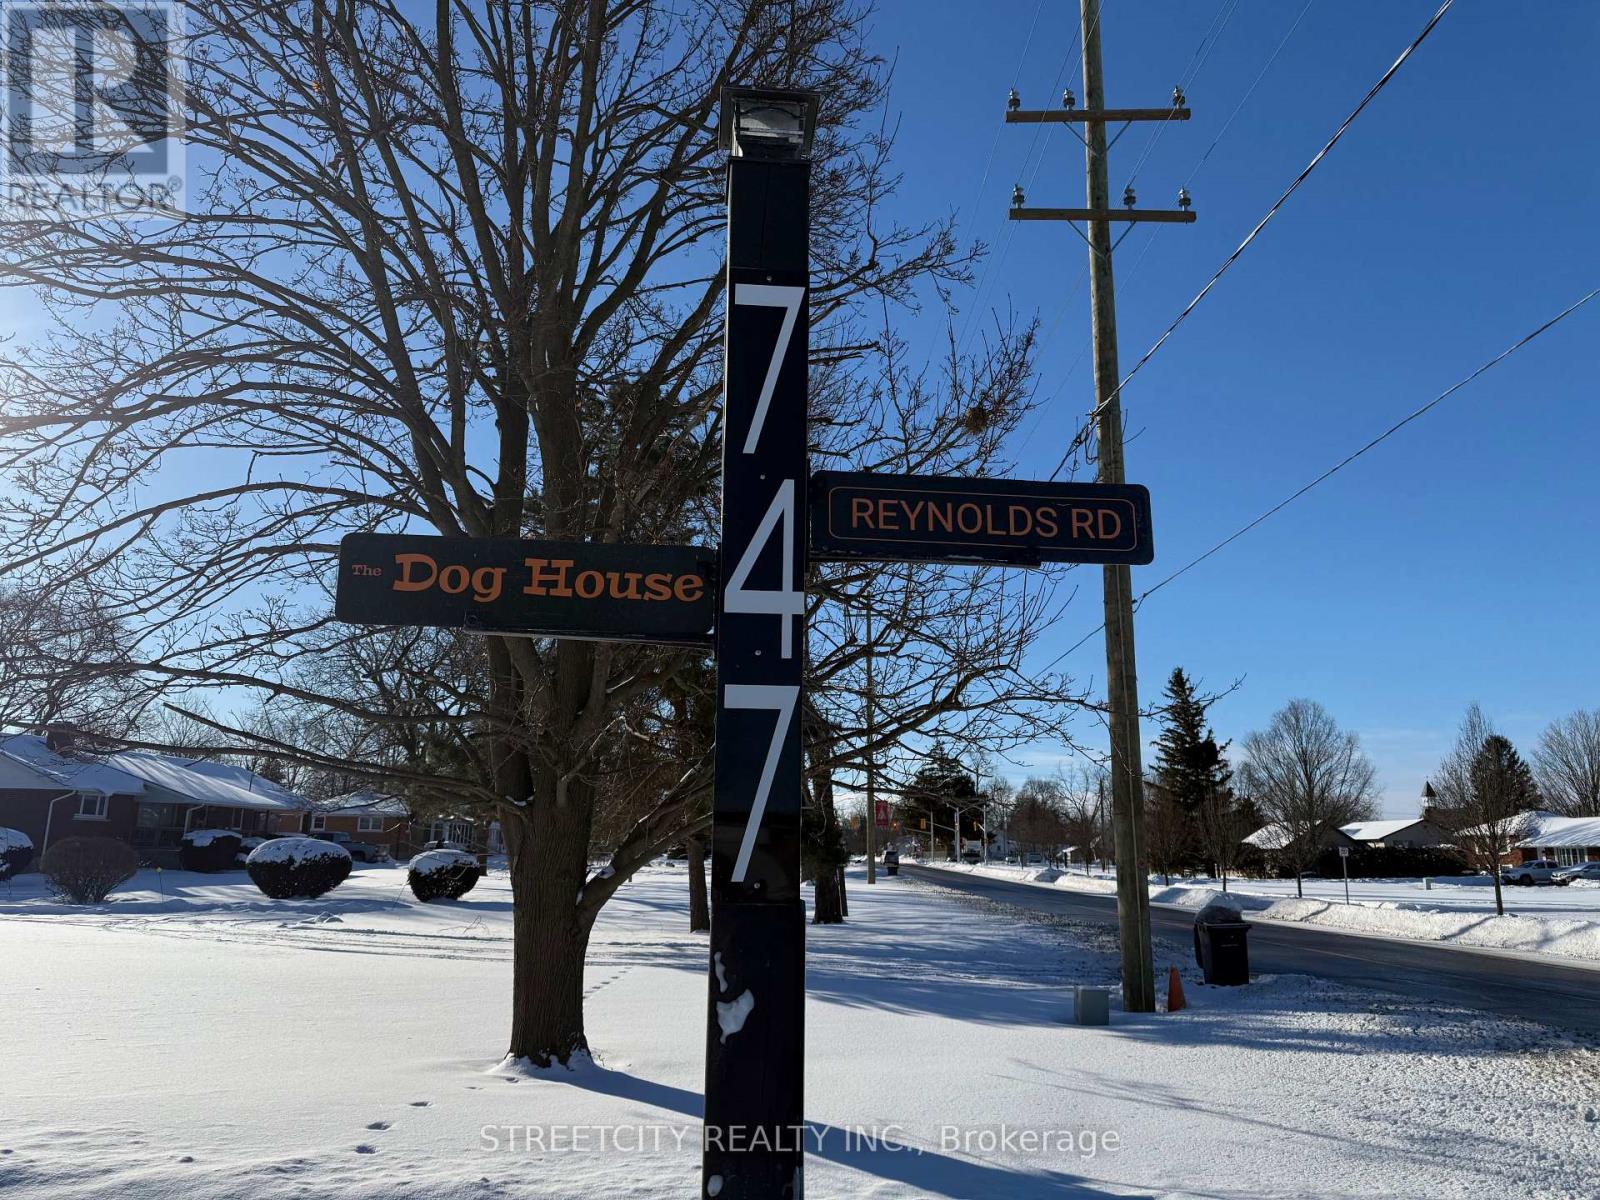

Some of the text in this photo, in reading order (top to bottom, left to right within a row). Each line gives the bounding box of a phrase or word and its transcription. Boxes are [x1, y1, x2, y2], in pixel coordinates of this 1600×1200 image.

[851, 498, 1122, 540] REYNOLDS RD
[352, 553, 704, 602] The Dog House
